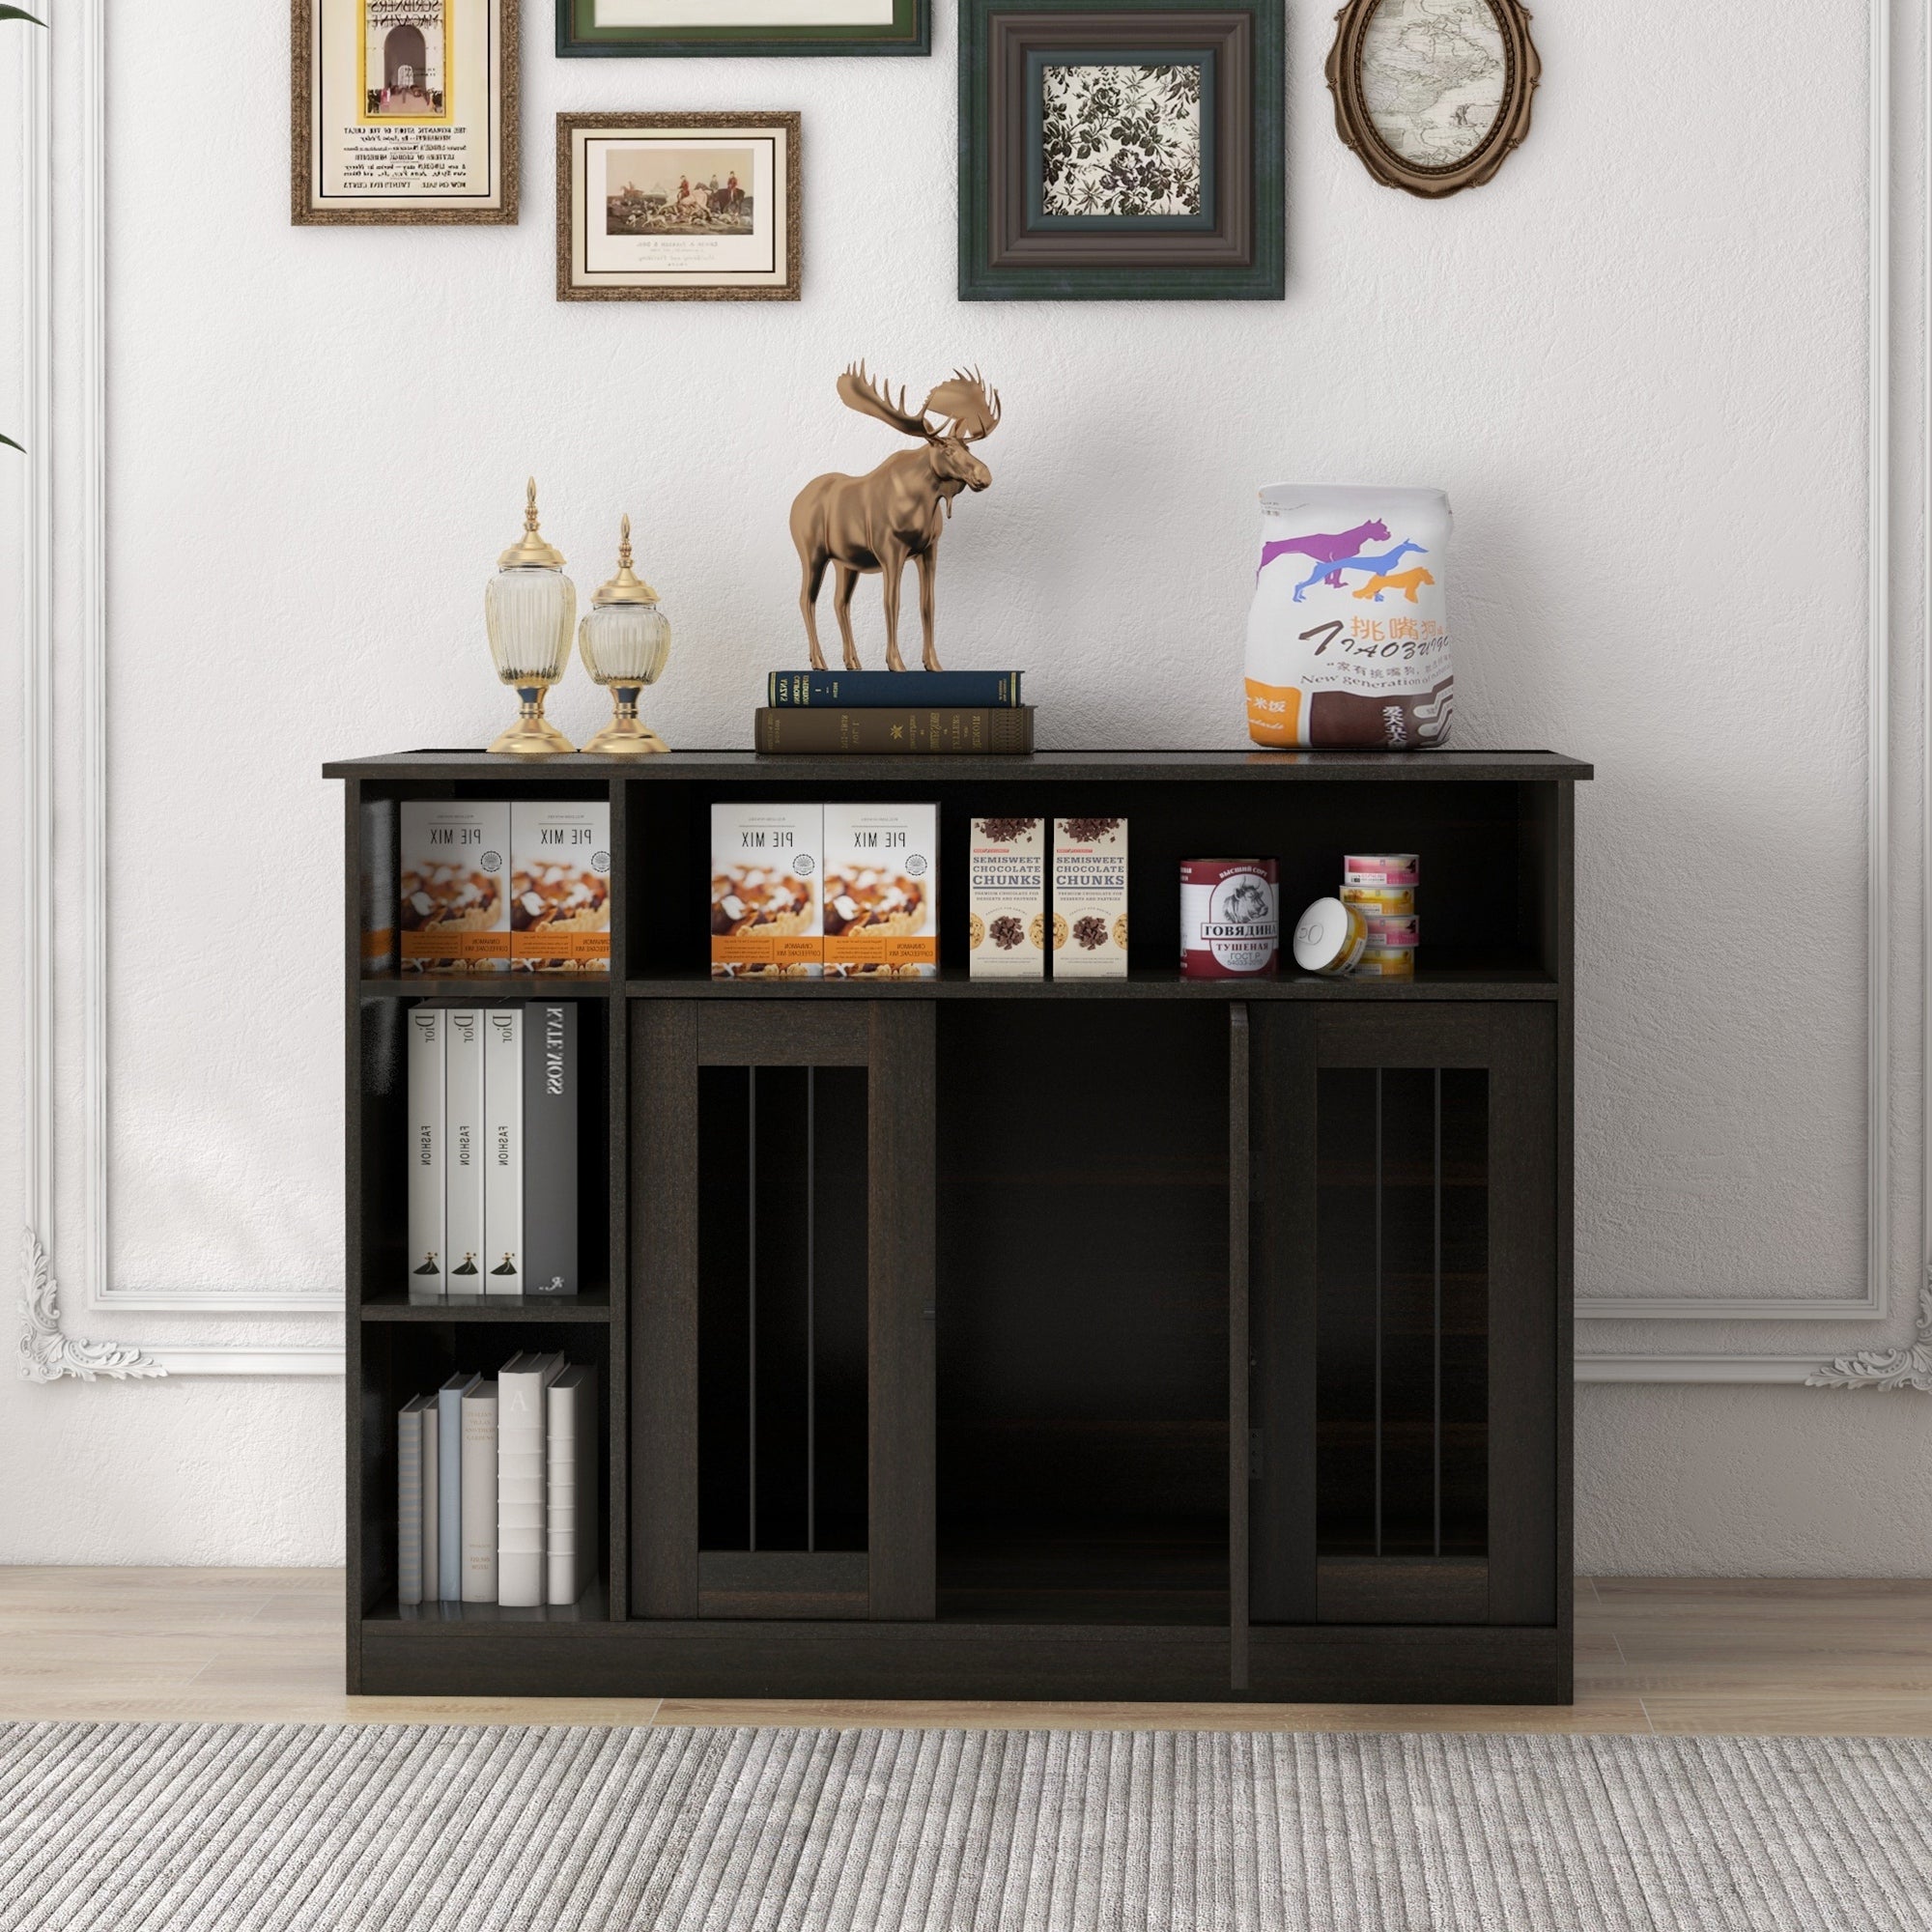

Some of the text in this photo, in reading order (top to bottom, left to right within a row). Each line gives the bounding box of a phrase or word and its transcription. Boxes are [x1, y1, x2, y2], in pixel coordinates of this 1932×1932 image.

[973, 875, 1041, 885] CHUNKS
[1056, 875, 1124, 885] CHUNKS
[1216, 943, 1268, 952] ТУШЕНАЯ
